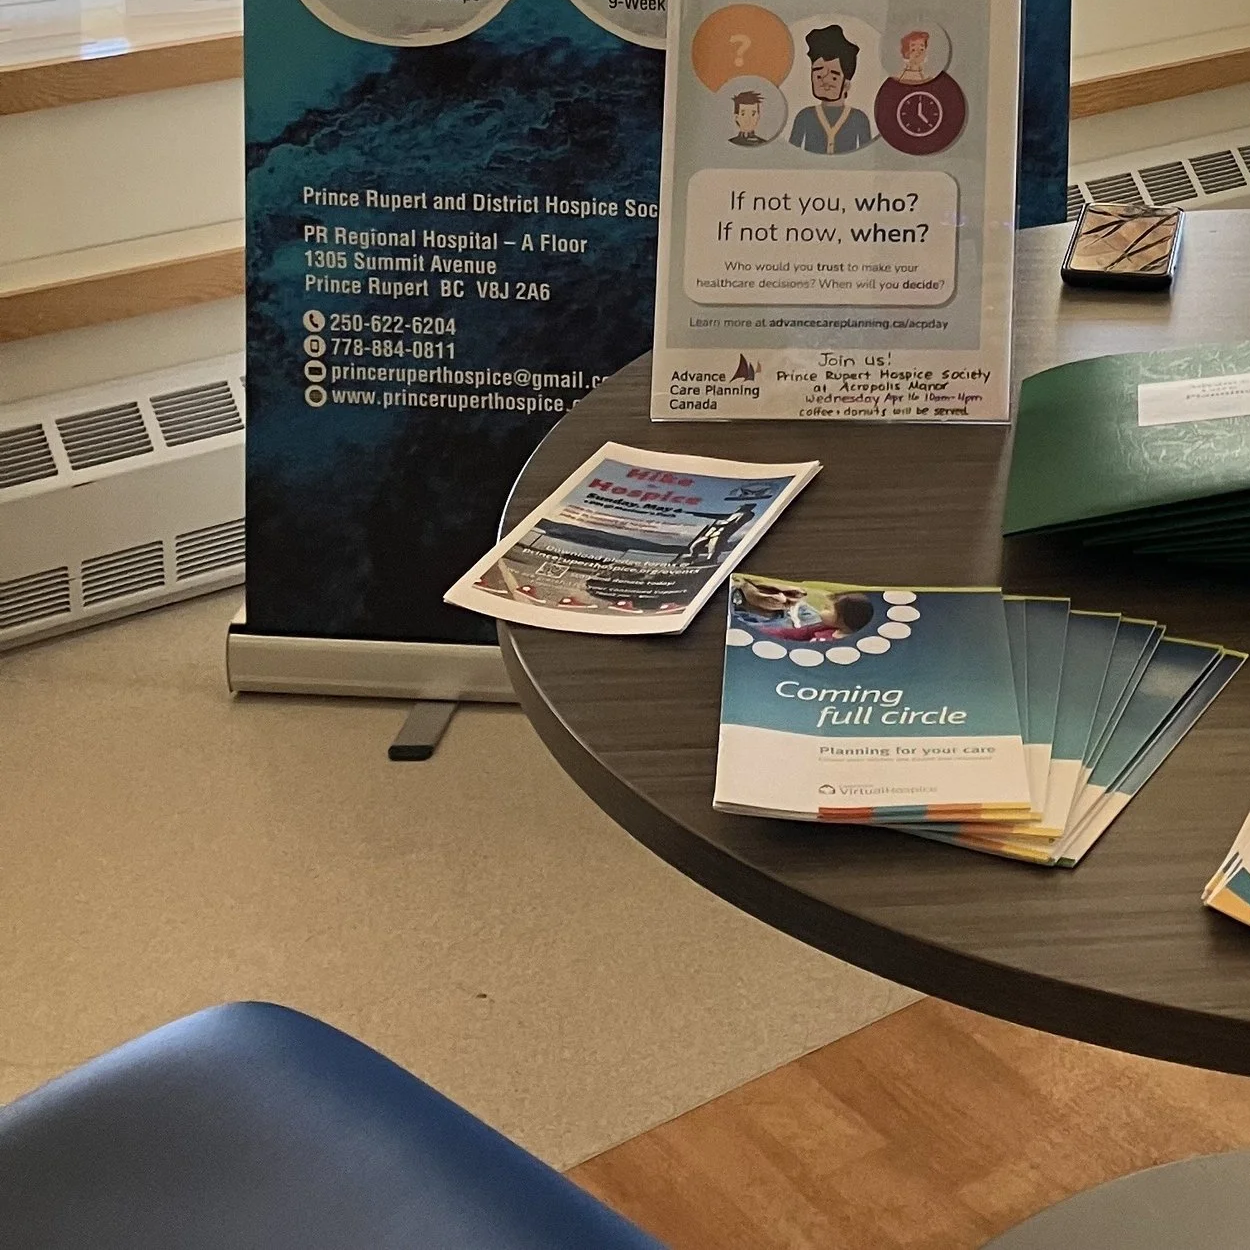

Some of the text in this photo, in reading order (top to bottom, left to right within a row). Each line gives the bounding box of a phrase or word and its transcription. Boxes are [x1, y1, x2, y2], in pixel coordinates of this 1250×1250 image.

[303, 187, 359, 207] Prince
[366, 189, 427, 212] Rupert
[432, 193, 466, 210] and
[472, 194, 539, 214] District
[545, 196, 618, 219] Hospice
[730, 190, 919, 216] If not you, who?
[303, 225, 588, 254] PR Regional Hospital A Floor
[717, 221, 929, 245] If not now, when?
[304, 250, 497, 275] 1305 Summit Avenue
[724, 261, 918, 274] Who would you trust to make your
[304, 274, 551, 301] Prince Rupert BC V8J 2A6
[696, 278, 945, 292] healthcare decisions? When will you decide?
[329, 313, 457, 336] 250-622-6204
[689, 317, 720, 328] Learn
[723, 319, 752, 328] more
[755, 319, 767, 328] at
[330, 338, 456, 360] 778-884-0811
[818, 352, 892, 367] Join us!
[671, 371, 726, 382] Advance
[776, 370, 818, 382] Prince
[825, 369, 872, 380] Rupert
[880, 369, 933, 381] Hospice
[669, 384, 760, 398] Care Planning
[839, 382, 901, 394] Acropolis
[908, 382, 949, 391] Manor
[669, 398, 717, 410] Canada
[916, 407, 929, 415] be
[774, 680, 904, 708] Coming
[816, 706, 968, 729] full circle
[819, 746, 996, 756] Planning for your care
